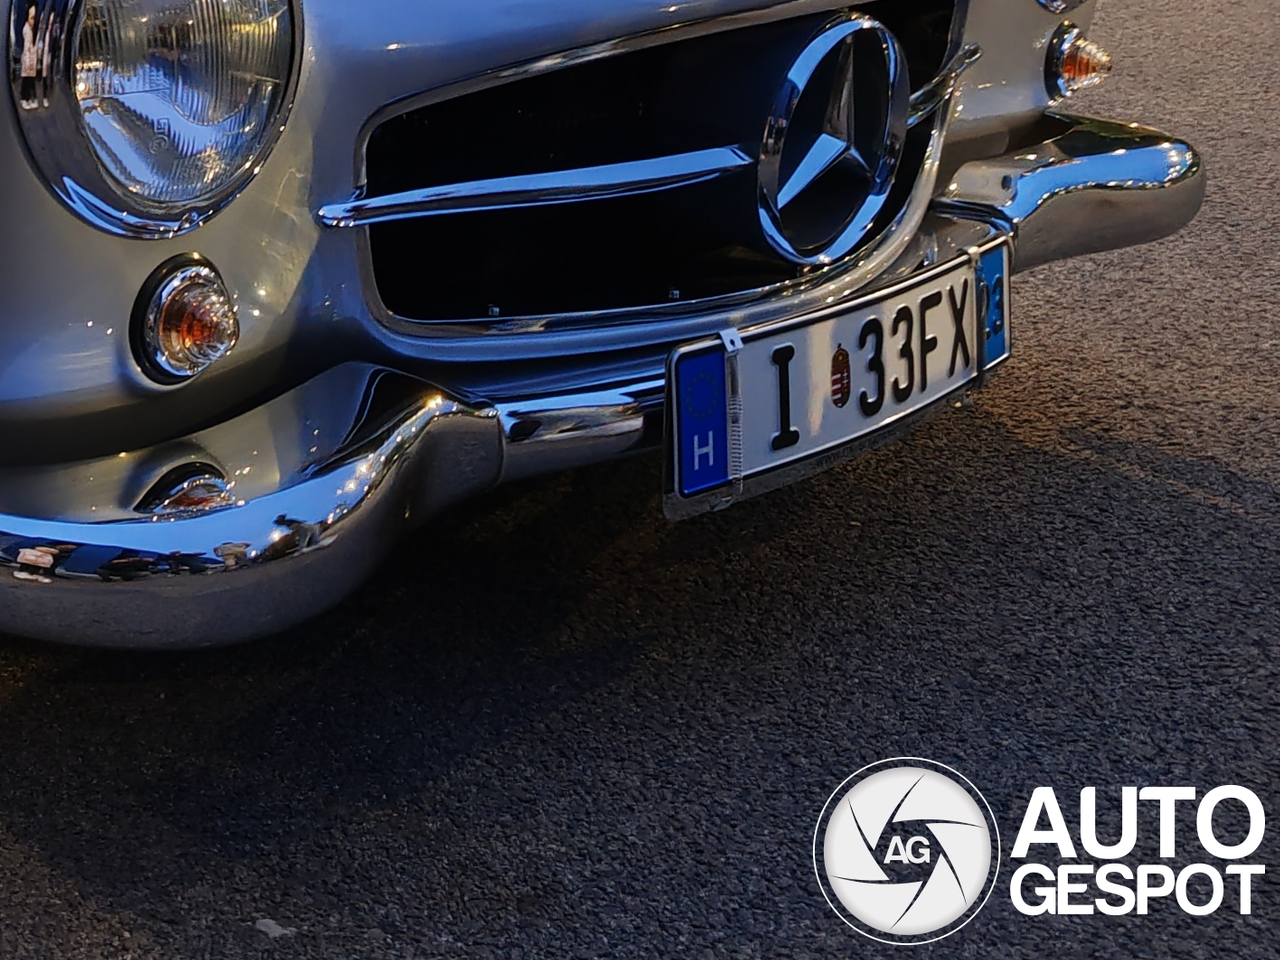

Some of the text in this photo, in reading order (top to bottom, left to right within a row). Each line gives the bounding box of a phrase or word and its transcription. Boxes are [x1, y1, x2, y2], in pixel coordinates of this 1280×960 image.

[771, 342, 800, 452] I
[858, 276, 971, 418] 33FX
[693, 430, 714, 471] H
